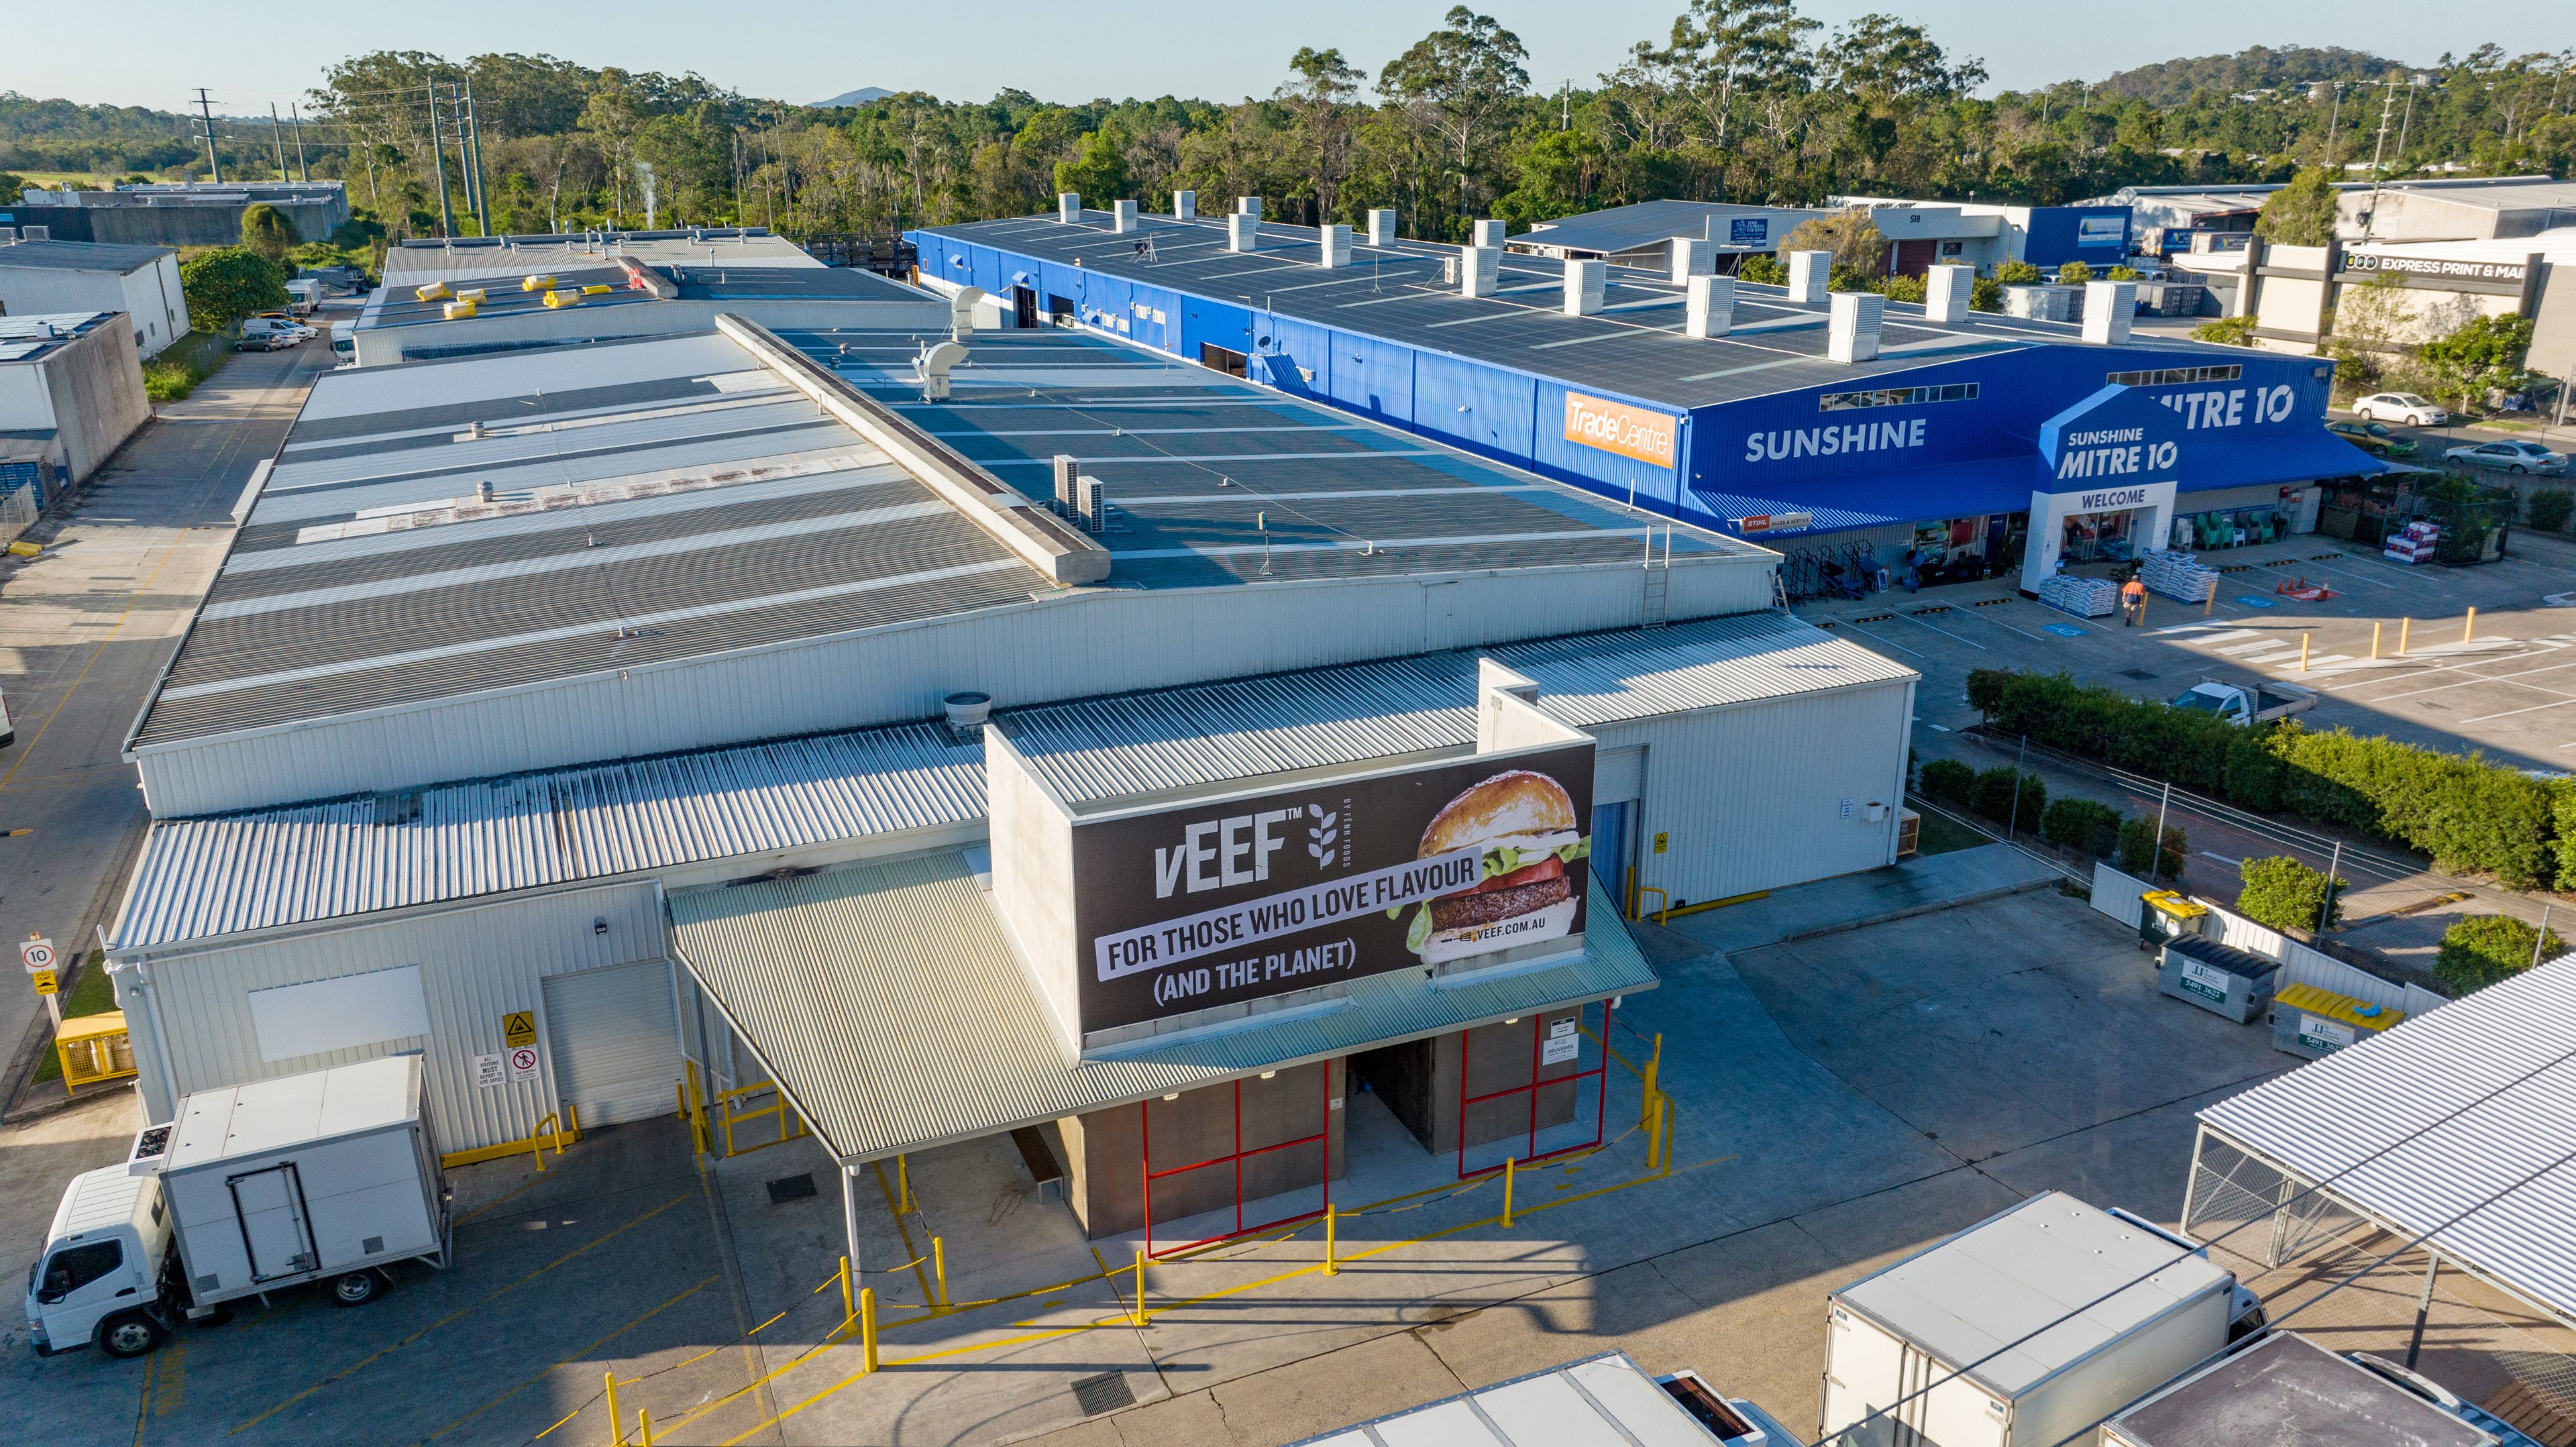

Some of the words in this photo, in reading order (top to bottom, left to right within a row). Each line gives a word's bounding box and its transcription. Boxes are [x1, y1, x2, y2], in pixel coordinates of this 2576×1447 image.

[1911, 215, 1921, 223] 518
[2381, 258, 2440, 274] EXPRESS
[2441, 262, 2483, 276] PRINT
[2483, 266, 2494, 277] &
[2255, 384, 2294, 423] 10
[1745, 419, 1926, 462] SUNSHINE
[2068, 428, 2143, 446] SUNSHINE
[2057, 446, 2141, 479] MITRE
[2147, 441, 2178, 470] 10
[2082, 489, 2145, 508] WELCOME
[1343, 798, 1351, 808] BY
[1108, 934, 1158, 971] FOR
[1163, 912, 1244, 956] THOSE
[1248, 898, 1305, 935] WHO
[1312, 881, 1369, 920] LOVE
[1376, 857, 1474, 904] FLAVOUR
[1477, 918, 1545, 940] VEEF.COM.AU
[30, 950, 47, 963] 10
[1154, 969, 1210, 1007] (AND
[1216, 958, 1259, 989] THE
[1265, 936, 1356, 981] PLANET)
[2185, 979, 2201, 990] 5491
[2204, 986, 2220, 998] 3622
[1548, 1044, 1574, 1054] DELIVERIES
[2306, 1036, 2323, 1047] 5491
